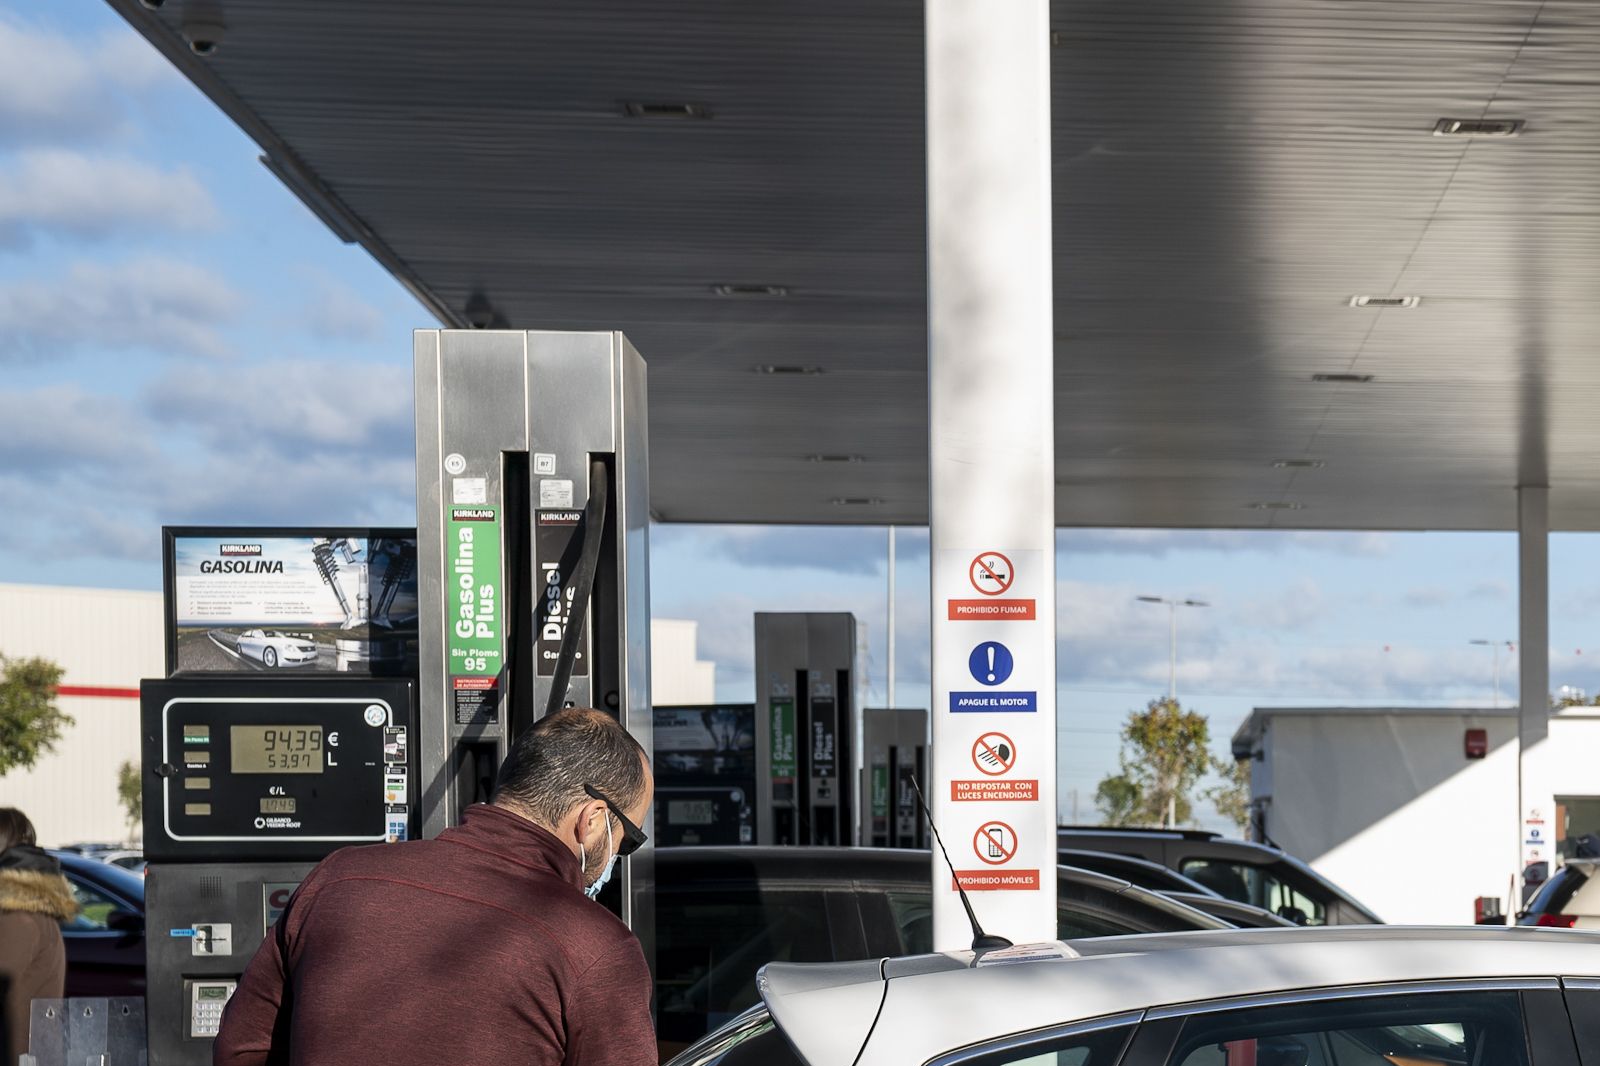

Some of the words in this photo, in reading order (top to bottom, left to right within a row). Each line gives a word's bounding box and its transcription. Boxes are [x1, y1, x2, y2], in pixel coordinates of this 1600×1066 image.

[453, 510, 494, 518] KIRKLAND
[540, 513, 580, 521] KIRKLAND
[221, 545, 261, 553] KIRKLAND
[200, 560, 284, 574] GASOLINA
[455, 527, 475, 639] Gasolina
[542, 562, 562, 640] Diesel
[475, 584, 495, 639] Plus
[452, 648, 467, 657] Sin
[473, 648, 499, 657] Plomo
[464, 657, 488, 671] 95
[958, 698, 989, 706] APAGUE
[990, 698, 999, 706] EL
[264, 731, 321, 751] 94,39
[327, 731, 339, 746] €
[268, 754, 311, 768] 53,97
[327, 752, 338, 766] L
[1014, 782, 1032, 790] CON
[983, 791, 1033, 799] ENCENDIDAS
[959, 877, 1000, 885] PROHIBIDO
[1002, 875, 1034, 884] MÓVILES
